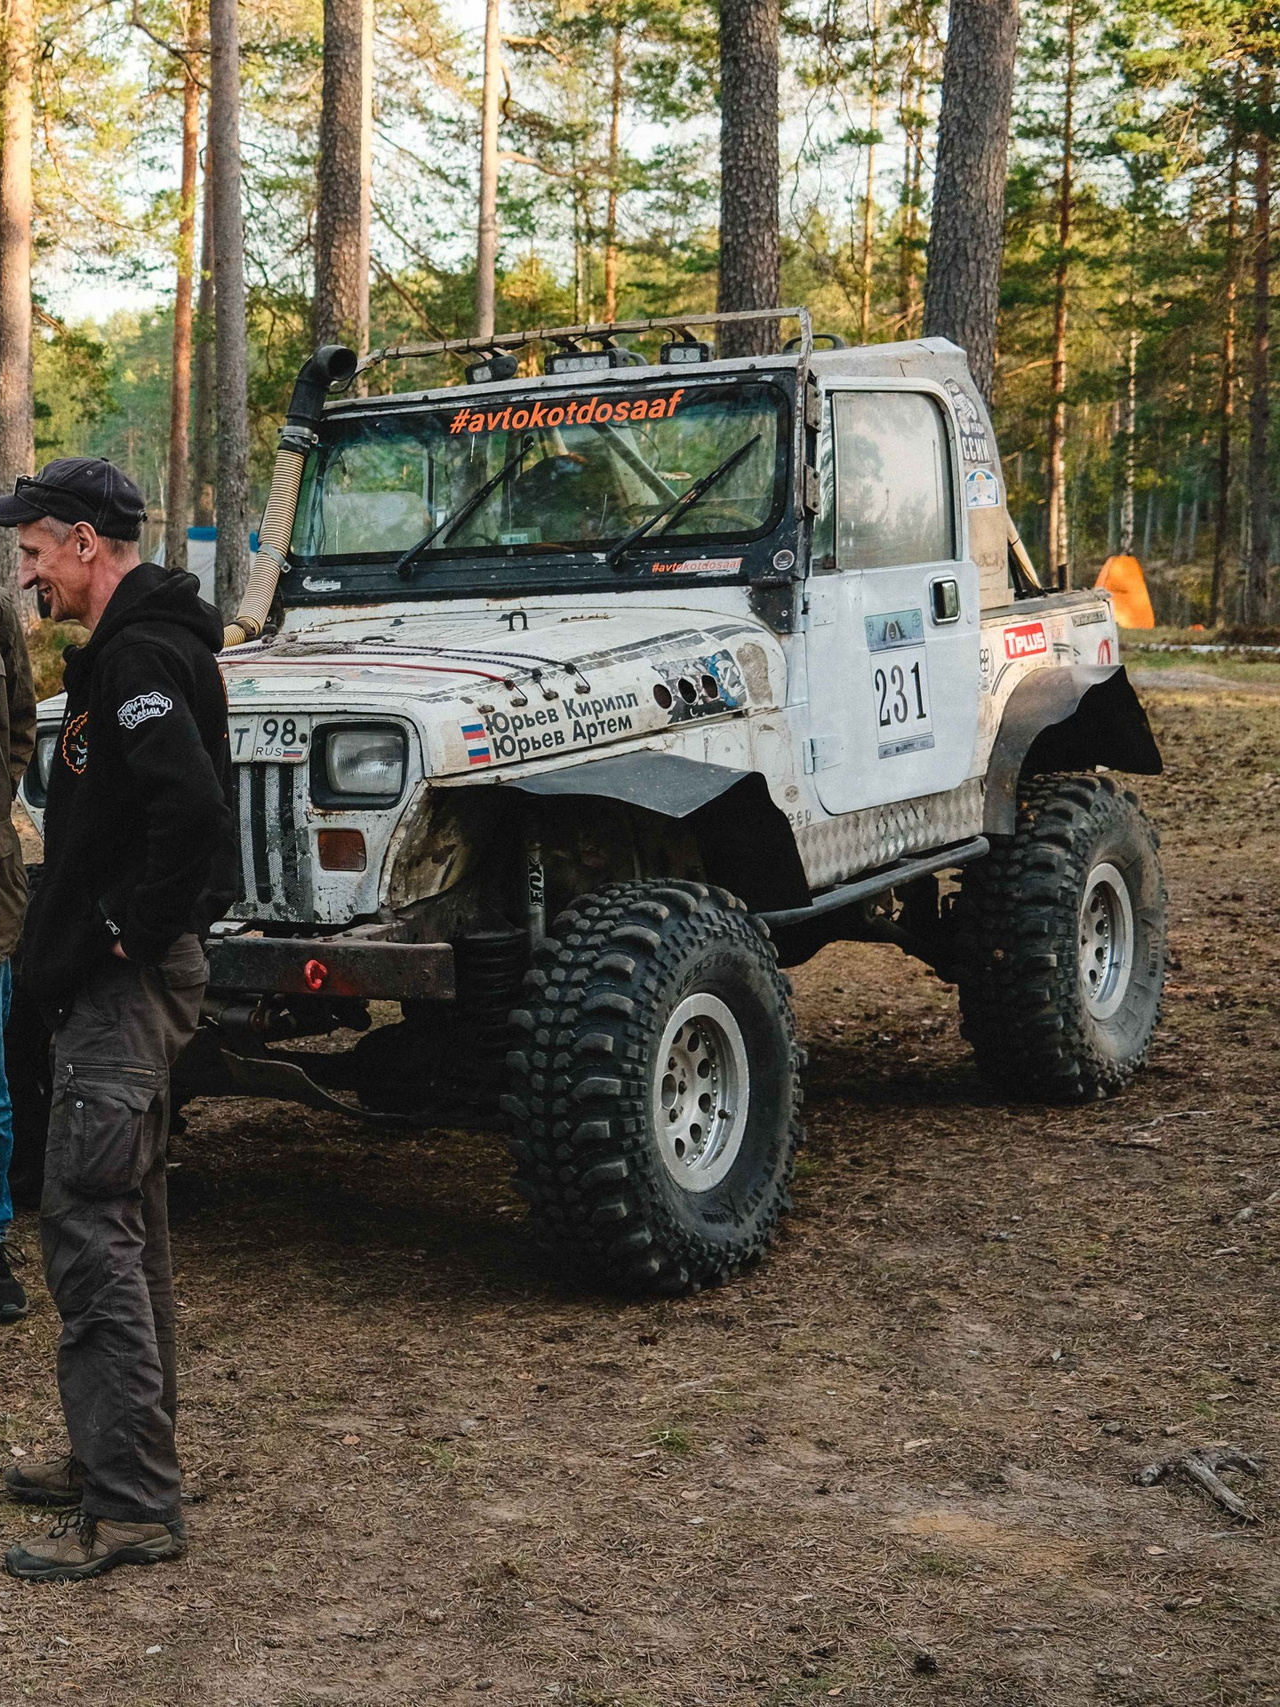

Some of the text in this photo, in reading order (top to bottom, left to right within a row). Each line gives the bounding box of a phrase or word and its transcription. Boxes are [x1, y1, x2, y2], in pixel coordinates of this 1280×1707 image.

[450, 389, 684, 434] #avtokotdosaaf
[651, 557, 744, 574] #avtokotdosaaf
[484, 692, 639, 736] Юрьев Кирилл
[875, 662, 927, 727] 231
[256, 747, 282, 756] RUS
[263, 719, 296, 746] 98
[492, 714, 632, 760] Юрьев Артем
[527, 855, 545, 907] FOX
